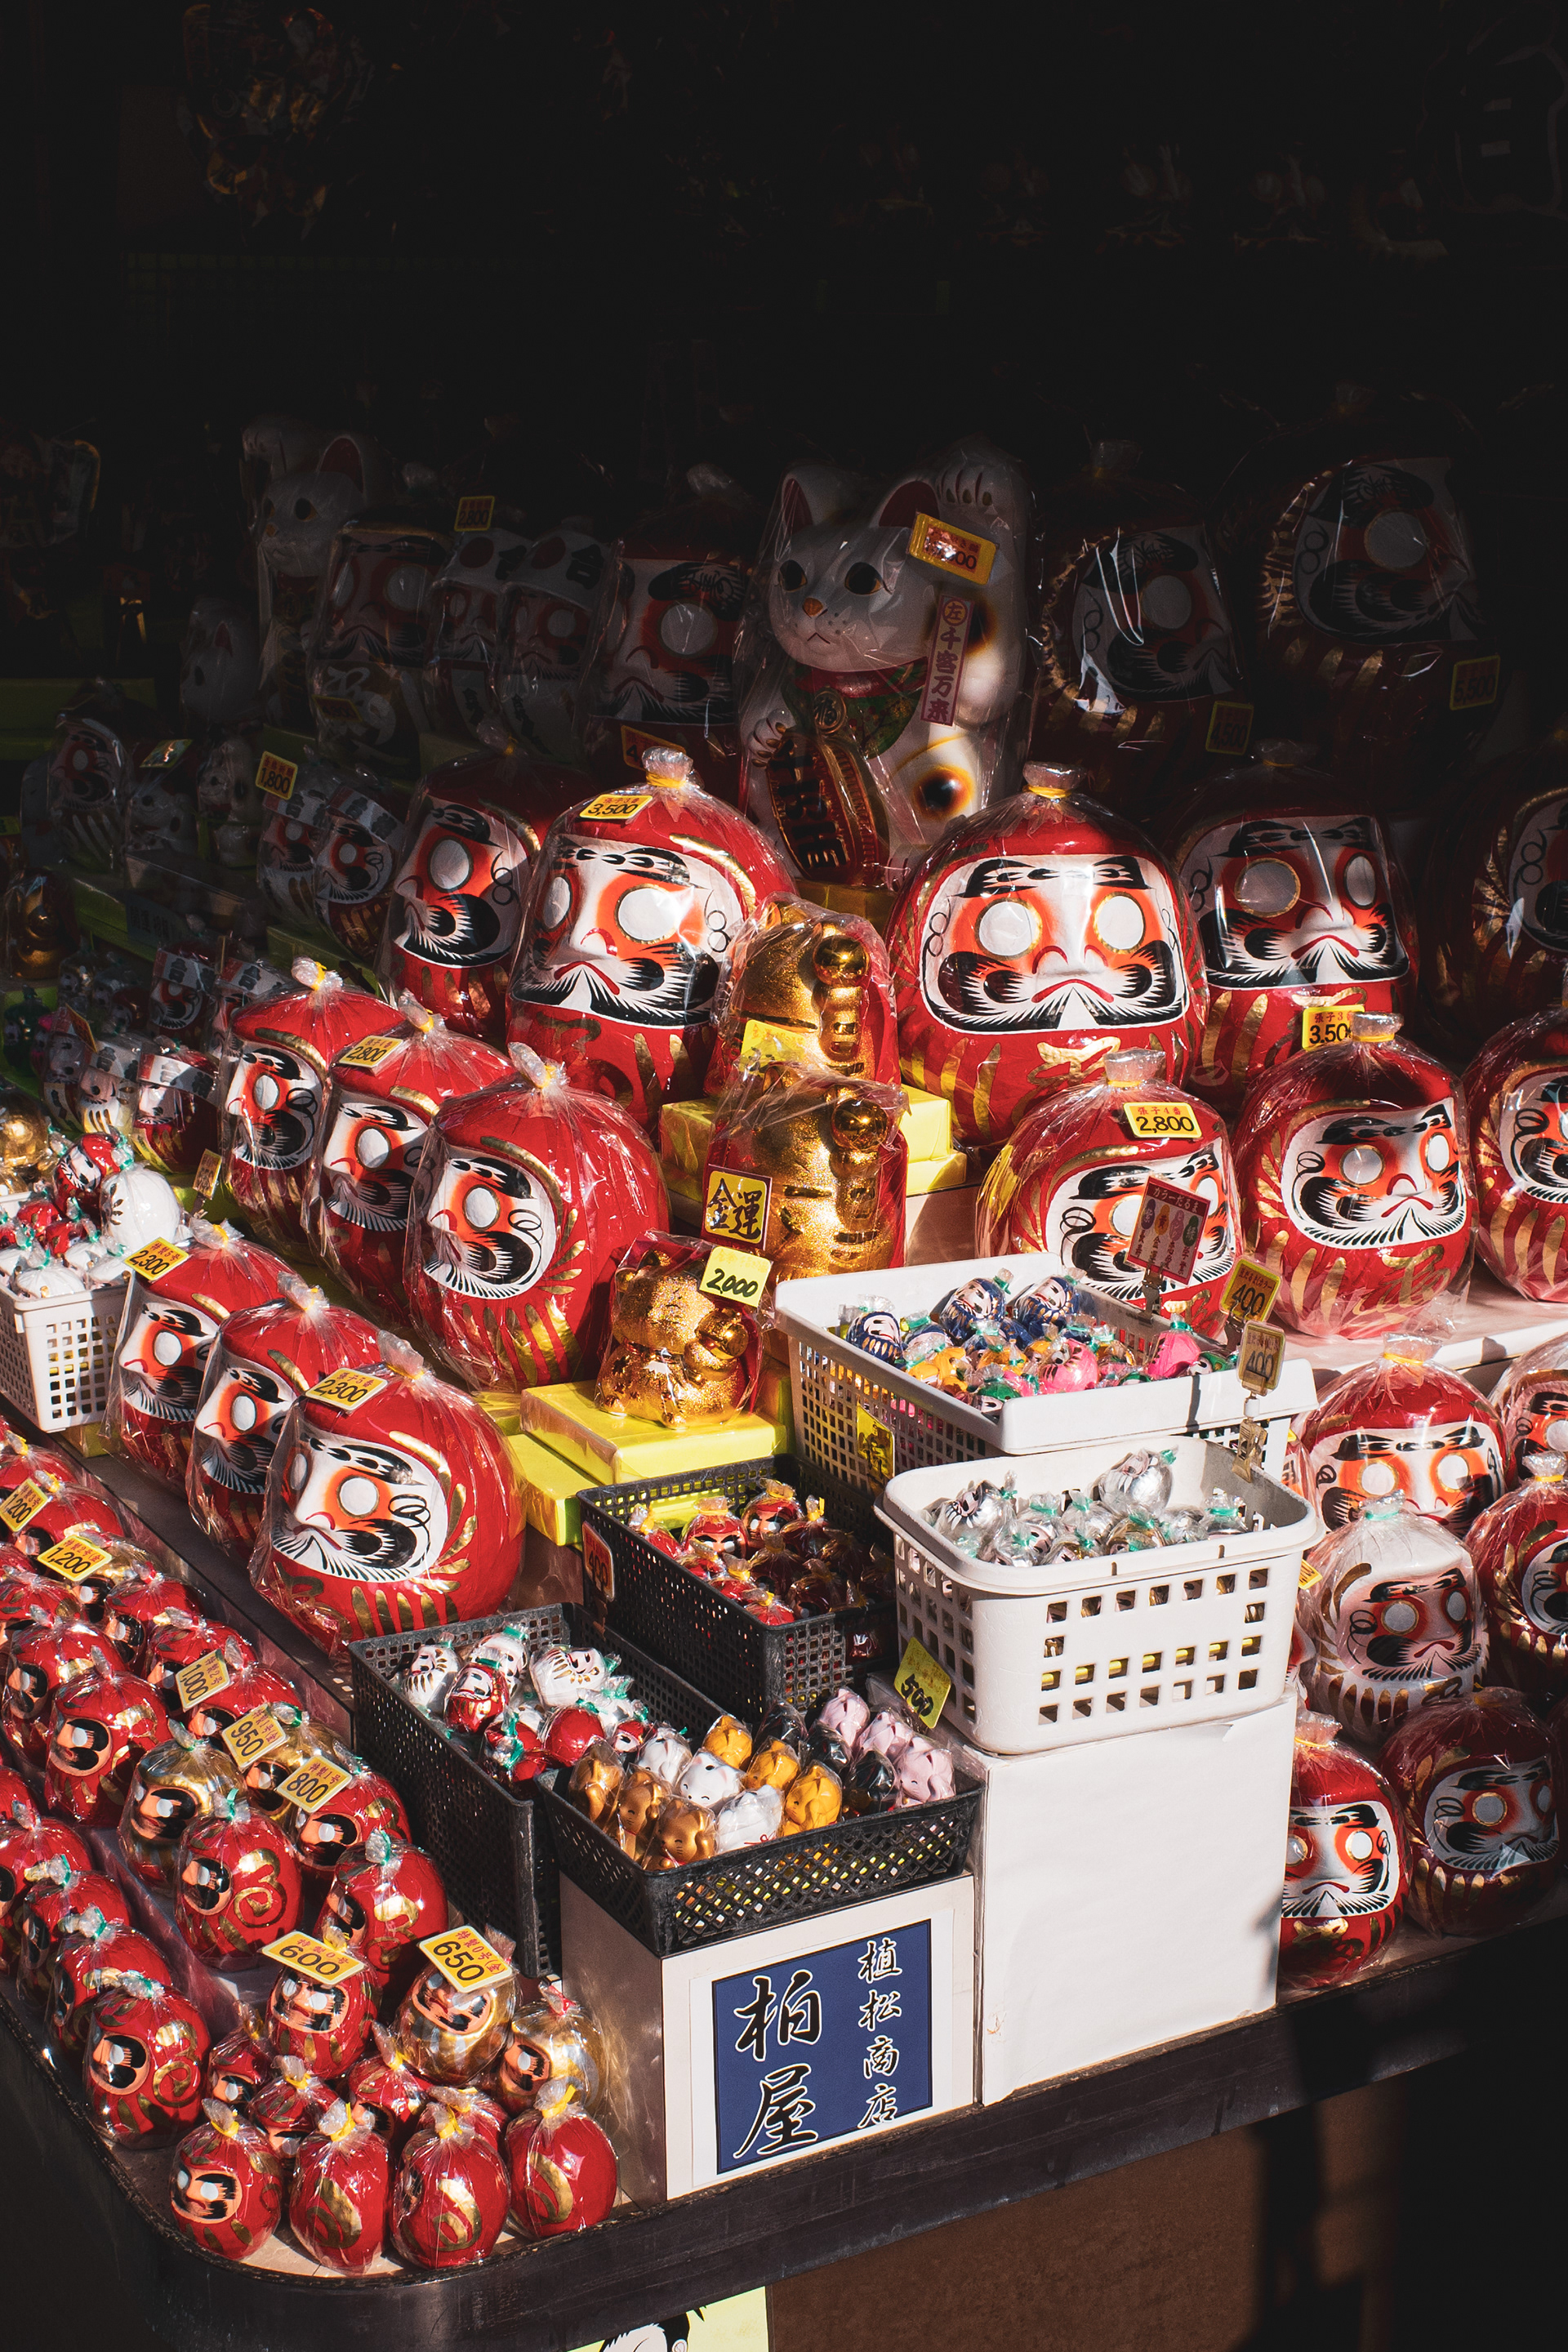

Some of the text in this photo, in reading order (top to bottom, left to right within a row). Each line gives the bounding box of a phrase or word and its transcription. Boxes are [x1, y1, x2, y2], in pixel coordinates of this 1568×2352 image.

[457, 510, 489, 527] 2,800
[1454, 674, 1497, 704] 5,500
[1211, 721, 1248, 749] 4,500
[260, 767, 291, 795] 1,800
[587, 803, 639, 816] 3,500
[345, 1045, 388, 1062] 2,800
[1136, 1115, 1196, 1134] 2,800
[706, 1177, 764, 1241] 金運
[129, 1250, 170, 1276] 2,300
[1232, 1284, 1266, 1316] 400
[314, 1379, 368, 1404] 2,300
[47, 1546, 91, 1575] 1,200
[589, 1550, 608, 1588] 400
[173, 1663, 209, 1702] 1,000
[901, 1673, 934, 1717] 500
[231, 1721, 265, 1757] 950
[287, 1772, 329, 1803] 800
[278, 1944, 341, 1976] 600
[433, 1940, 485, 1982] 650
[858, 1937, 902, 2129] 植松商店
[733, 1969, 822, 2158] 柏屋
